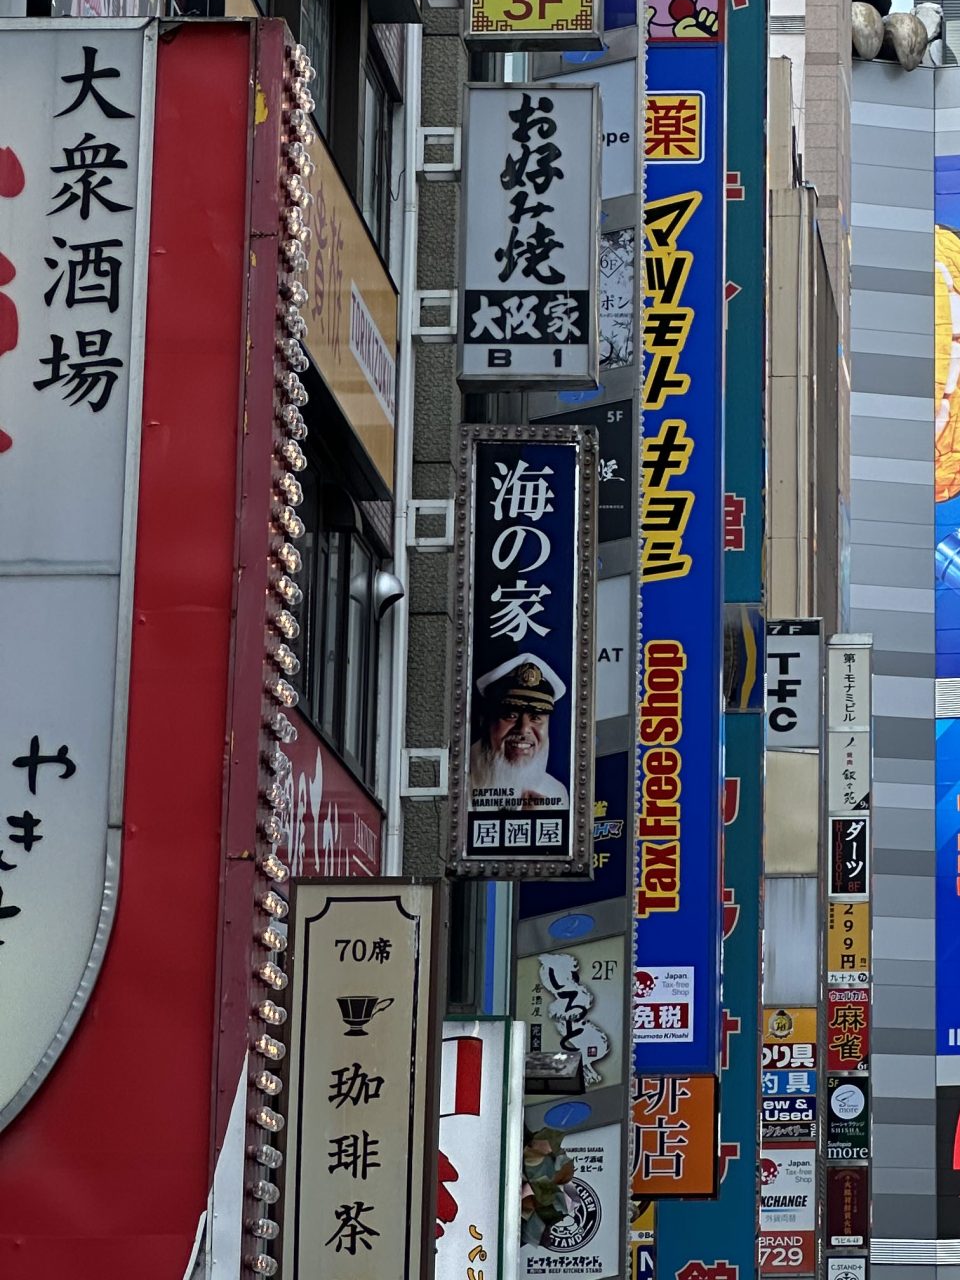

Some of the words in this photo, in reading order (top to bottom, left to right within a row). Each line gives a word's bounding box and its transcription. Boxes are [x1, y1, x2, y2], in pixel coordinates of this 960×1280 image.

[643, 100, 699, 157] 薬
[495, 92, 566, 286] お好み焼
[33, 46, 135, 412] 大衆酒場
[471, 295, 582, 341] 大阪家
[607, 411, 624, 423] 5F
[489, 460, 556, 643] 海の家
[638, 641, 688, 745] Shop
[472, 798, 504, 807] MARINE
[637, 750, 681, 838] Free
[475, 822, 561, 844] 居酒屋
[845, 820, 865, 878] ダーツ
[637, 839, 680, 918] Tax
[334, 936, 393, 965] 70席
[591, 960, 618, 981] 2F
[633, 1005, 682, 1029] 免税
[829, 1003, 867, 1062] 麻雀
[828, 1078, 839, 1088] 5F
[765, 1109, 813, 1121] Used
[795, 1099, 808, 1109] &
[327, 1061, 385, 1255] 珈琲茶
[827, 1147, 869, 1159] more
[759, 1236, 803, 1246] BRAND
[759, 1247, 803, 1266] 729
